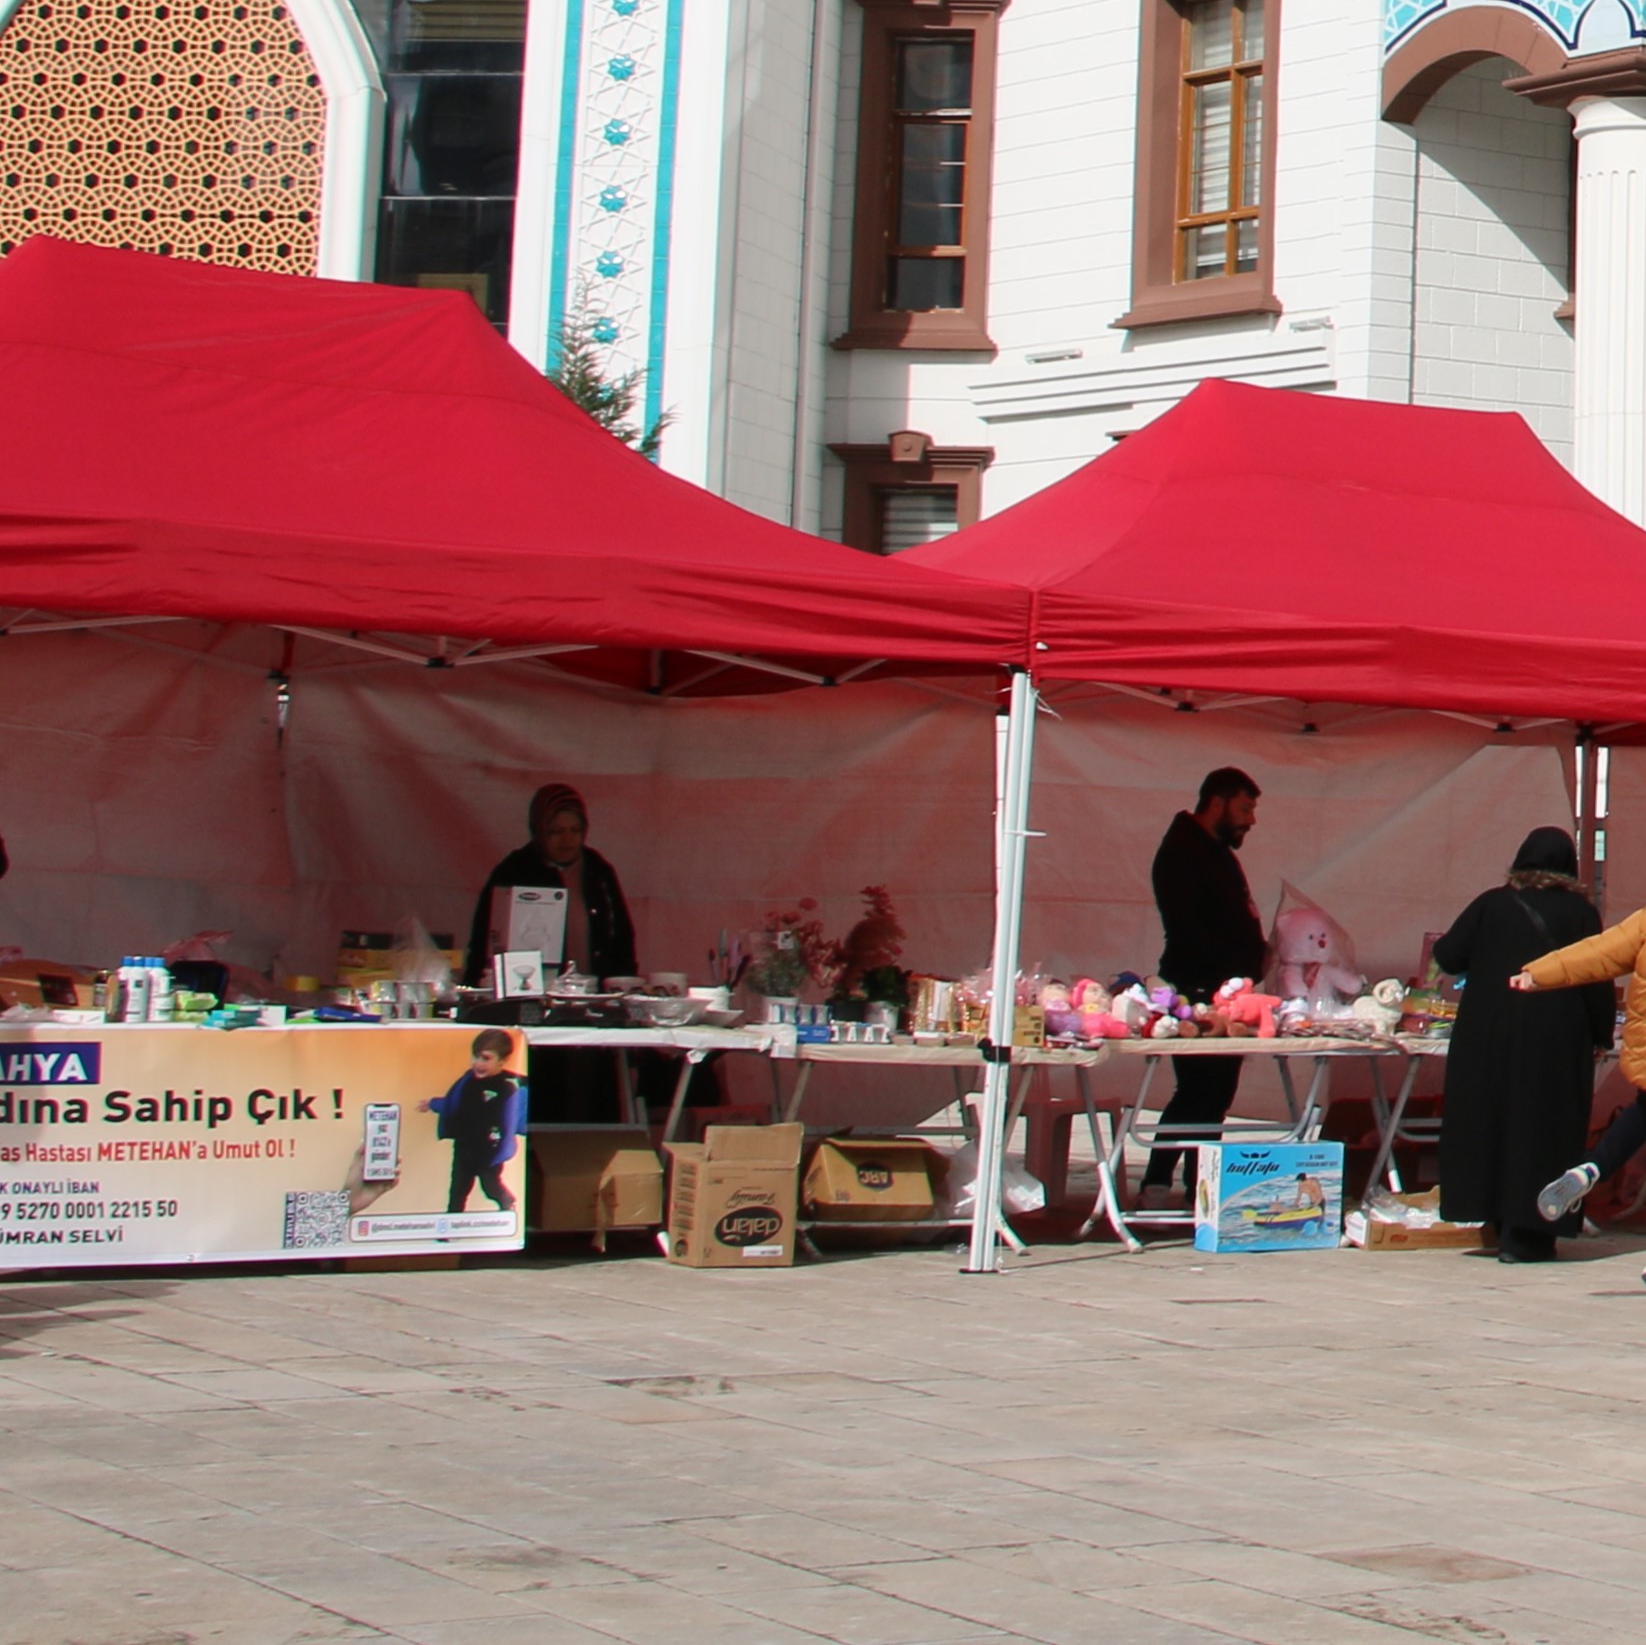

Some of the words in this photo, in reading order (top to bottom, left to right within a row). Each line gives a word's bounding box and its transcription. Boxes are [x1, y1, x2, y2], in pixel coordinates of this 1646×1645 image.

[0, 1052, 88, 1082] HYA
[103, 1089, 234, 1129] Sahip
[248, 1088, 318, 1125] Çık
[25, 1142, 92, 1162] Hastası
[212, 1140, 260, 1159] Umut
[12, 1181, 64, 1195] ONAYLI
[67, 1178, 100, 1194] İBAN
[16, 1202, 61, 1220] 5270
[65, 1201, 105, 1219] 0001
[110, 1200, 153, 1218] 2215
[156, 1200, 178, 1218] 50
[69, 1226, 124, 1244] SELVİ
[722, 1217, 780, 1236] dalan
